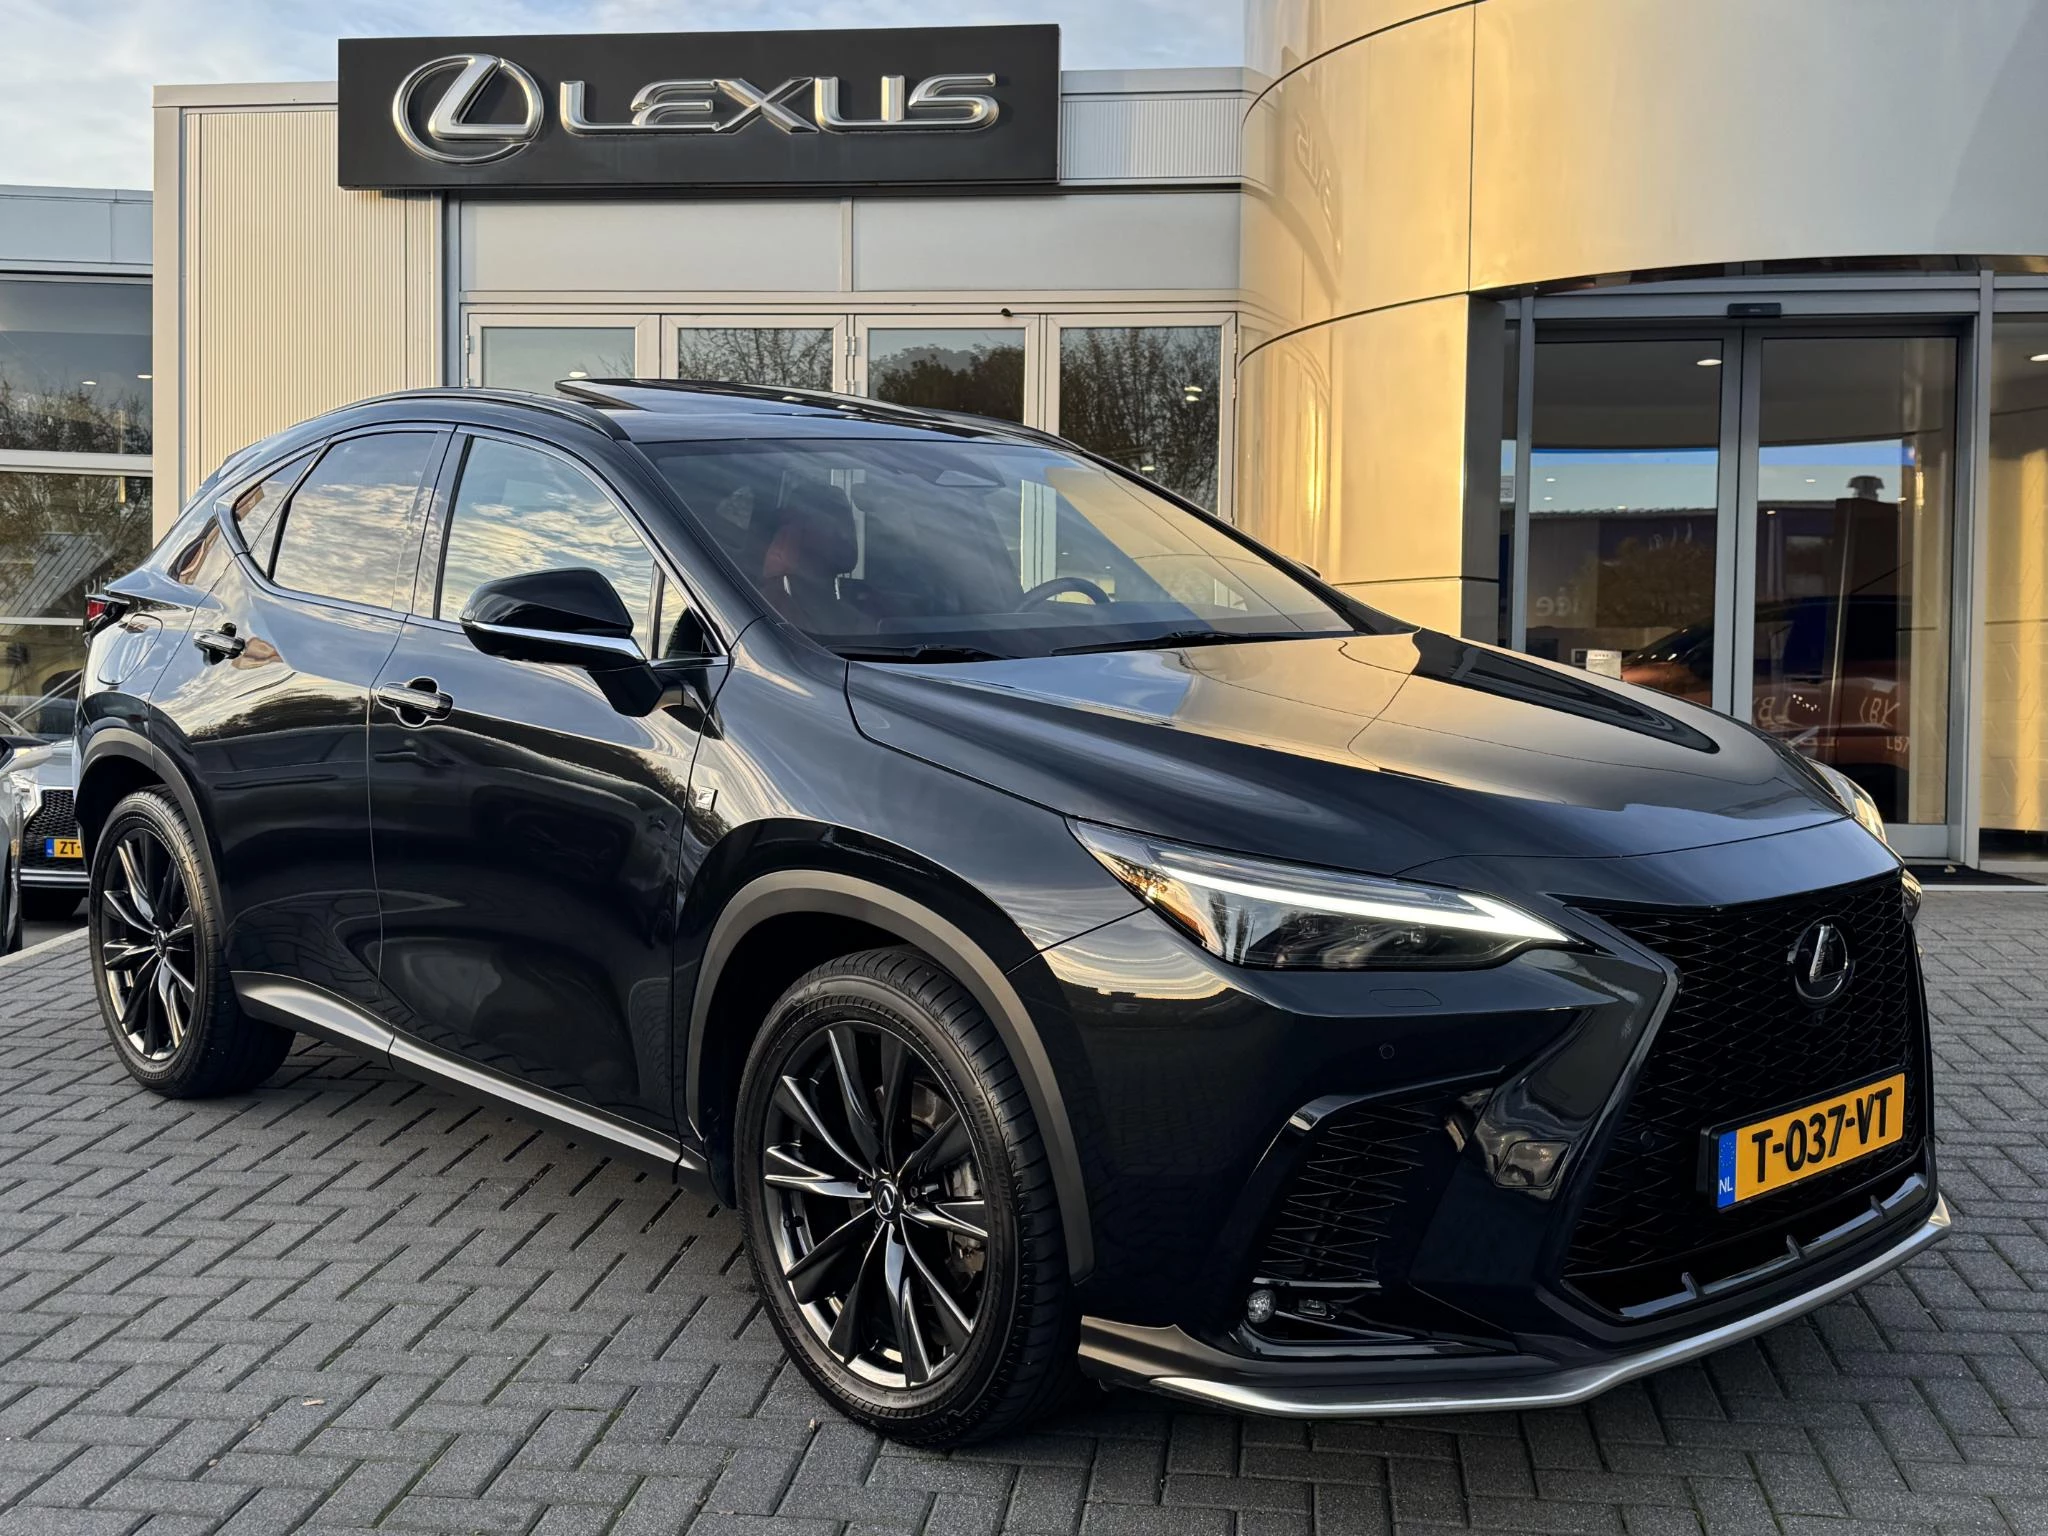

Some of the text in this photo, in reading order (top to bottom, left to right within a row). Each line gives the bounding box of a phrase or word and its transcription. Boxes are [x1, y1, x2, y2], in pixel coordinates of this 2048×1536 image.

[559, 74, 1002, 135] LEXUS
[1752, 1087, 1893, 1183] T-037-VT
[1719, 1176, 1733, 1195] NL
